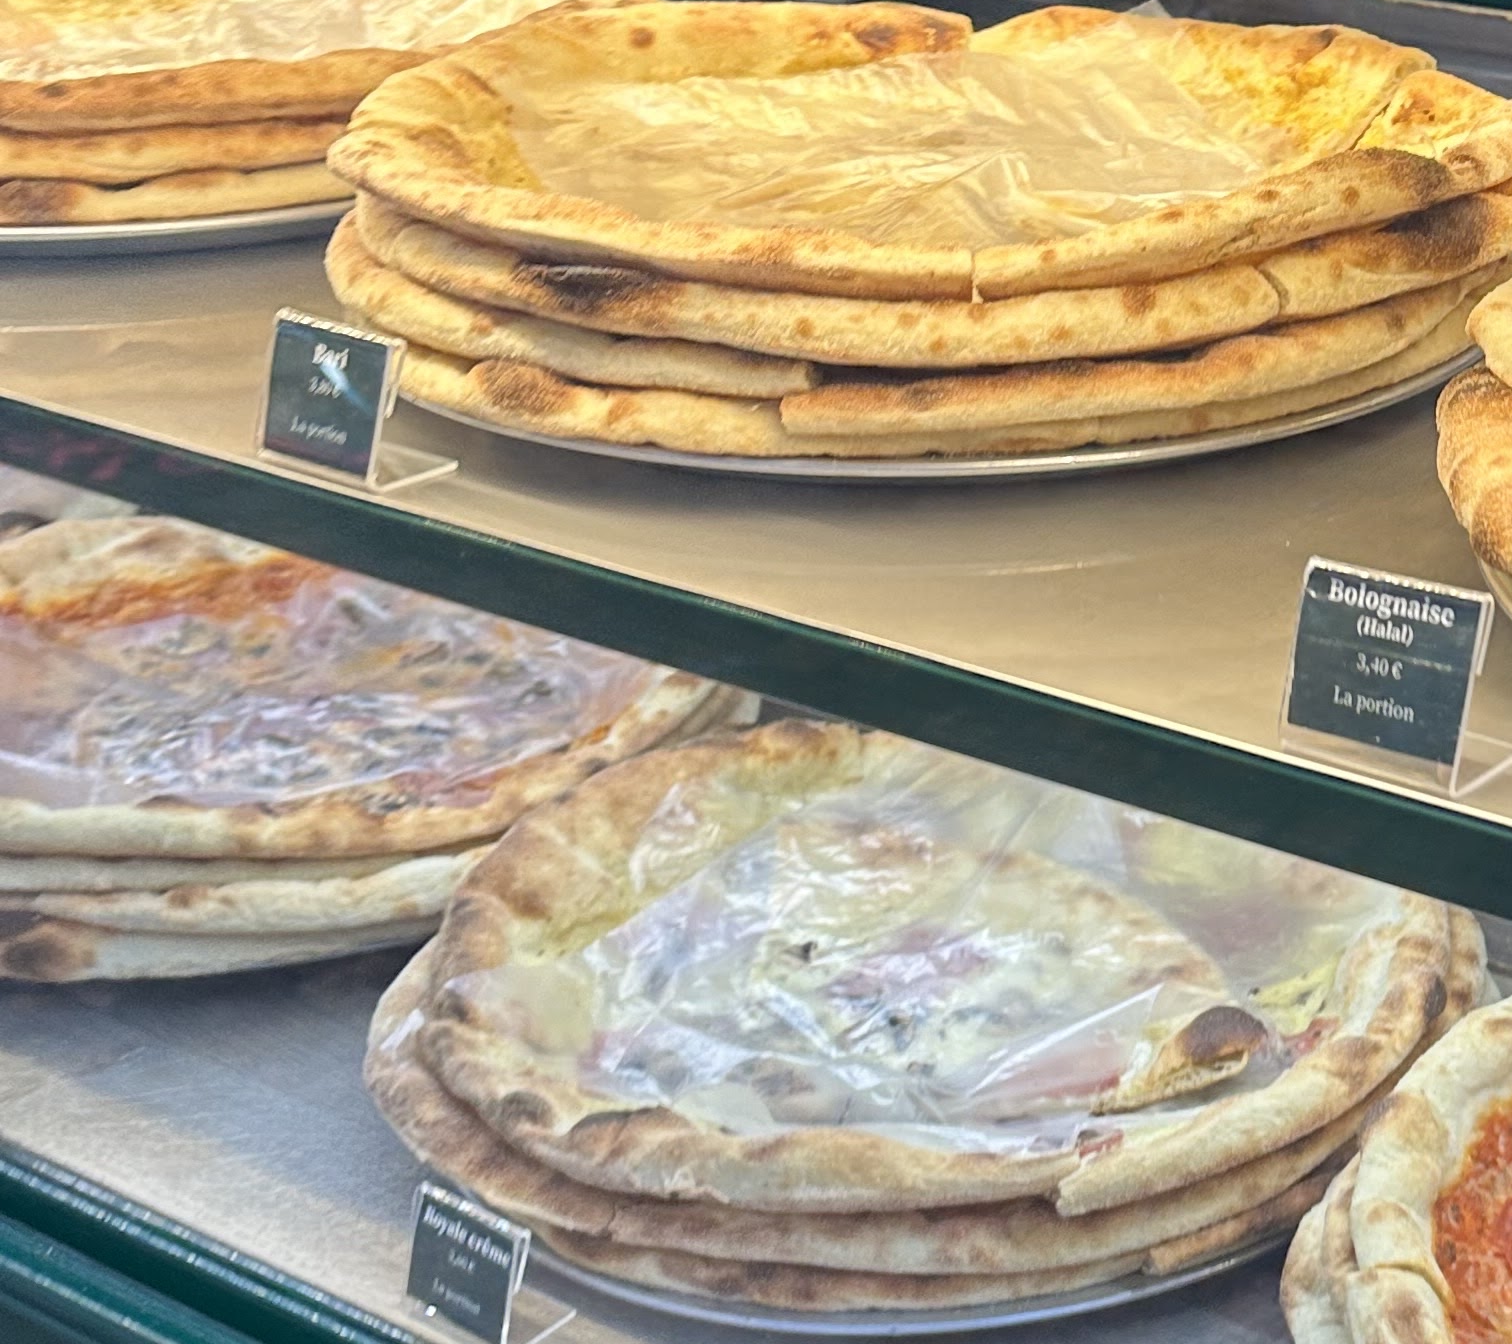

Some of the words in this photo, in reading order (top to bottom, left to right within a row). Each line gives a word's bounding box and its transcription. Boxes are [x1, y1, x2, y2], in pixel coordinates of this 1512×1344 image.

[1327, 576, 1456, 628] Bolognaise
[1356, 614, 1414, 647] (Halal)
[1333, 684, 1353, 707] La
[1355, 693, 1415, 723] portion
